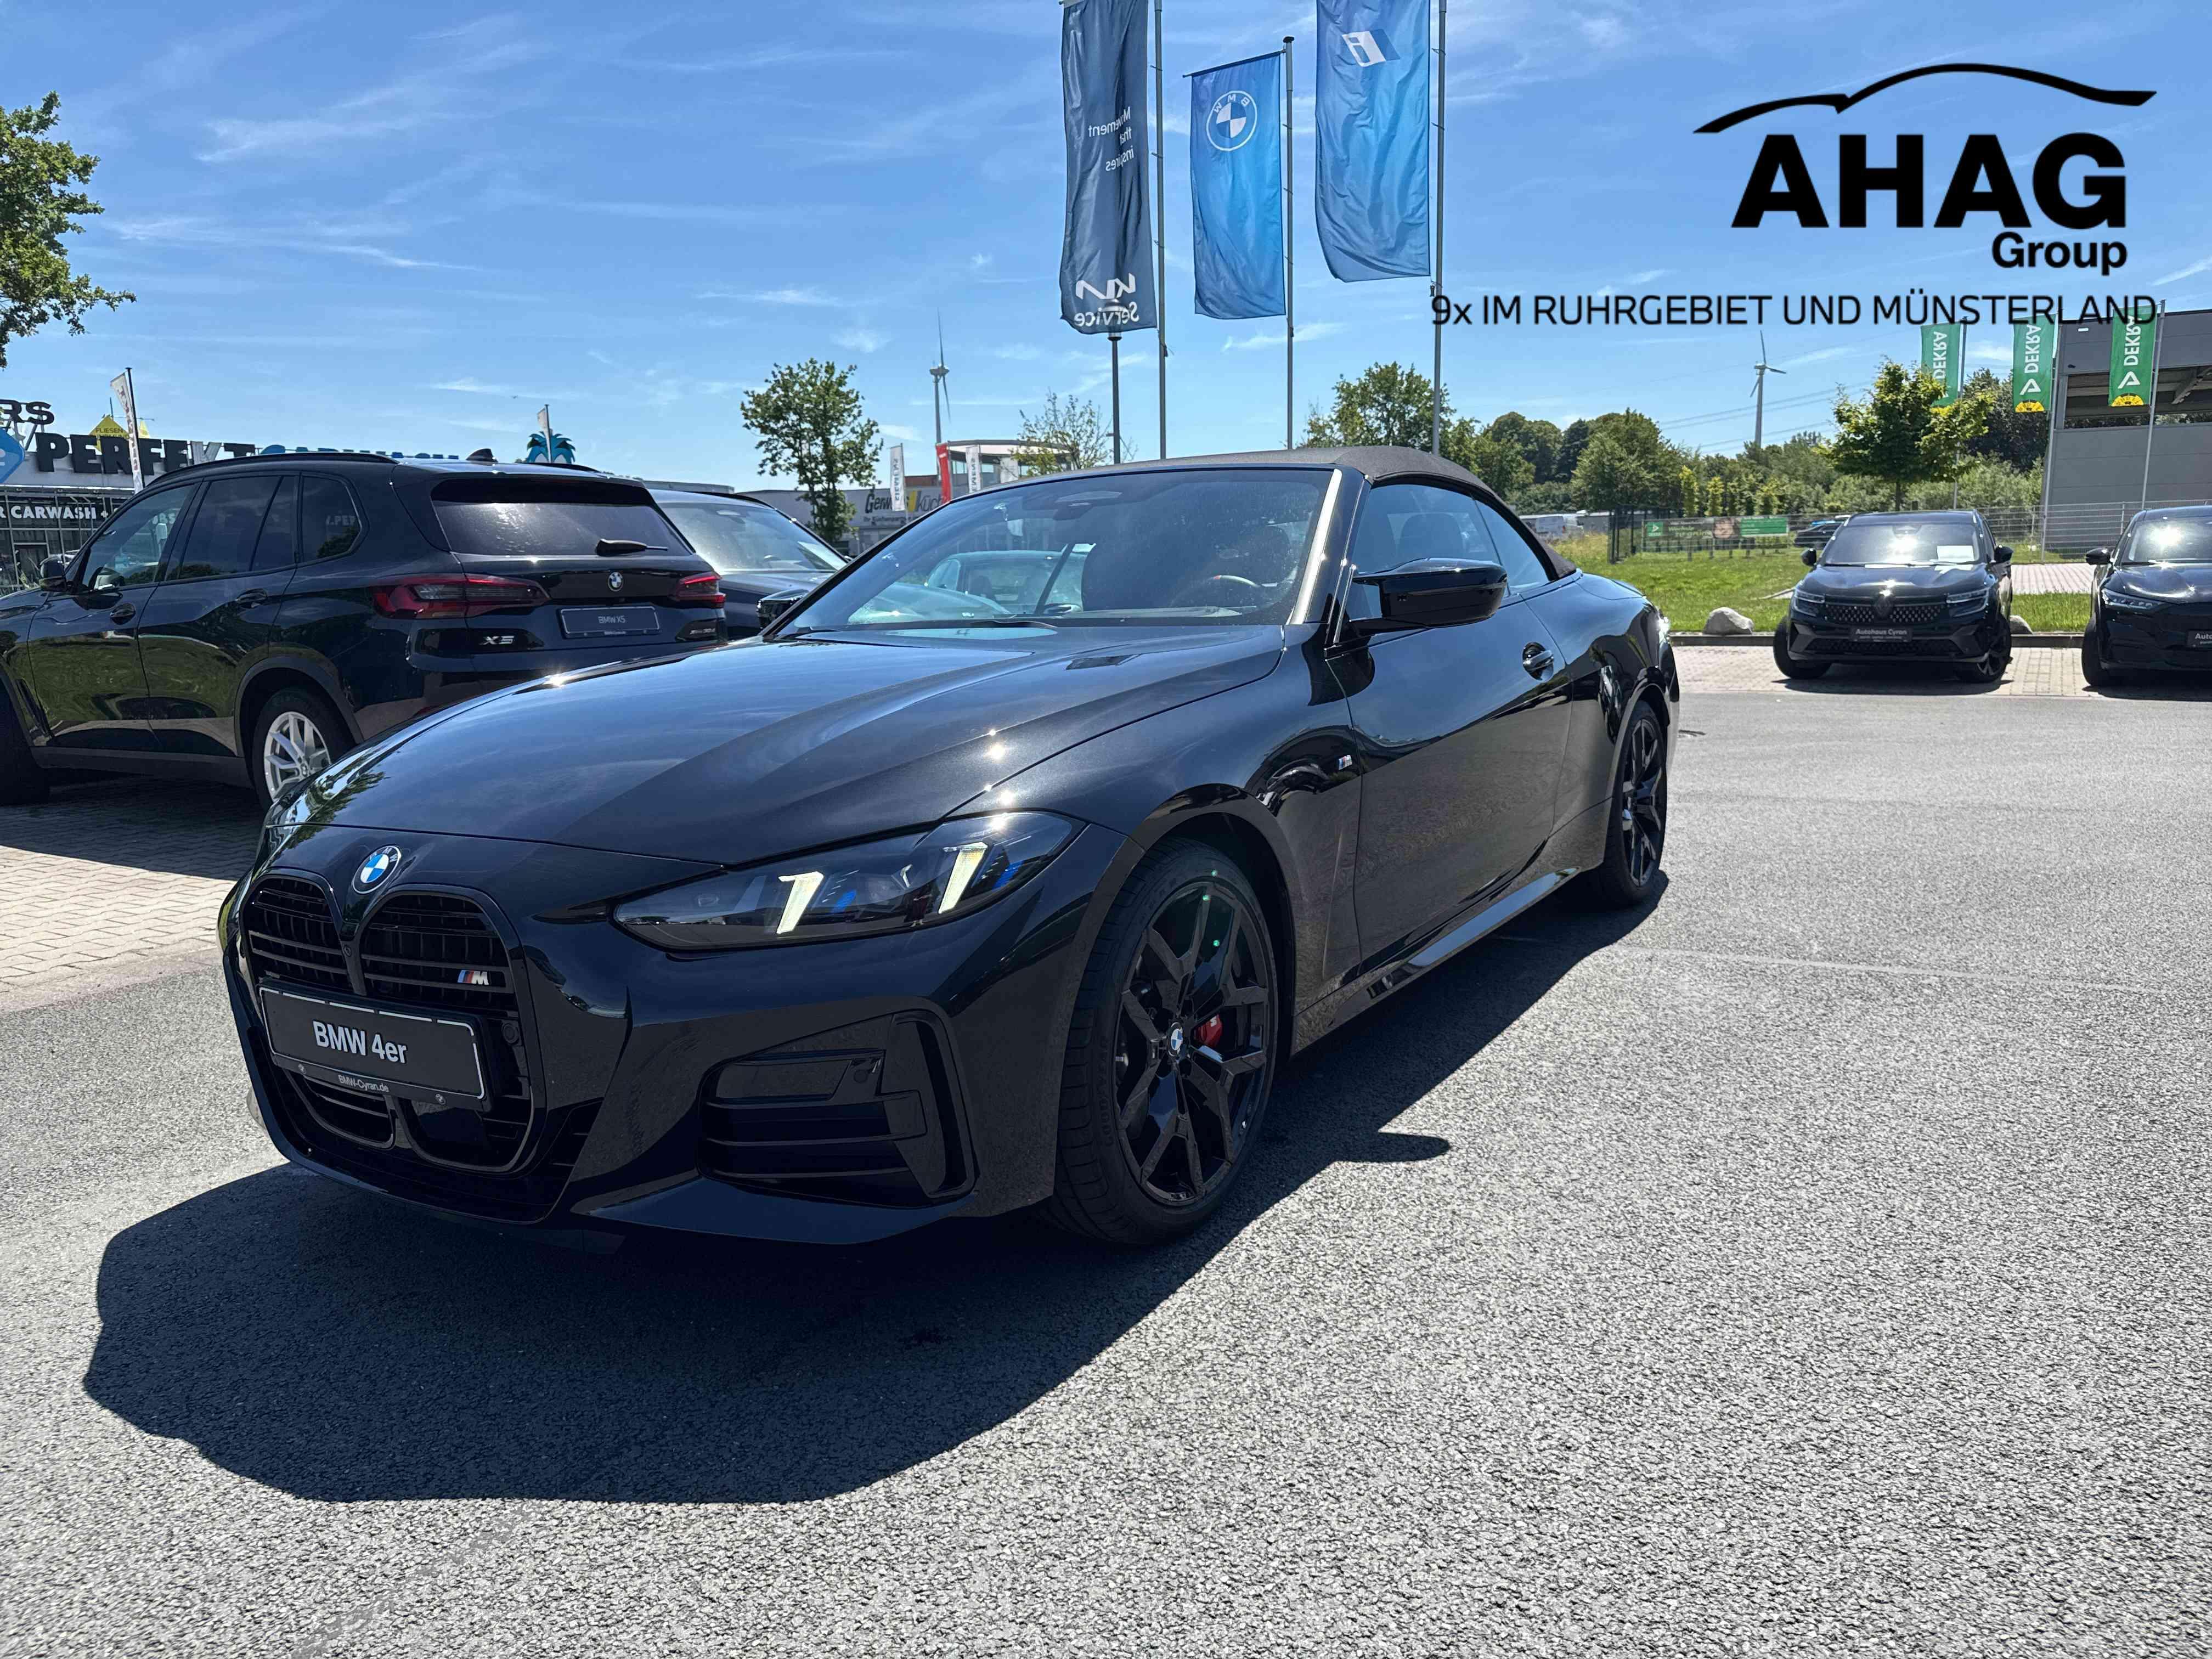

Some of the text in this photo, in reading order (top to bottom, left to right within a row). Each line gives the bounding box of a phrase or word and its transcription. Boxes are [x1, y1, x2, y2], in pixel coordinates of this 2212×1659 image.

[11, 506, 97, 519] CARWASH
[598, 615, 625, 624] BMW X5
[479, 635, 514, 645] X5
[313, 1020, 407, 1064] BMW 4er
[338, 1074, 390, 1093] BMW-Cyran.de
